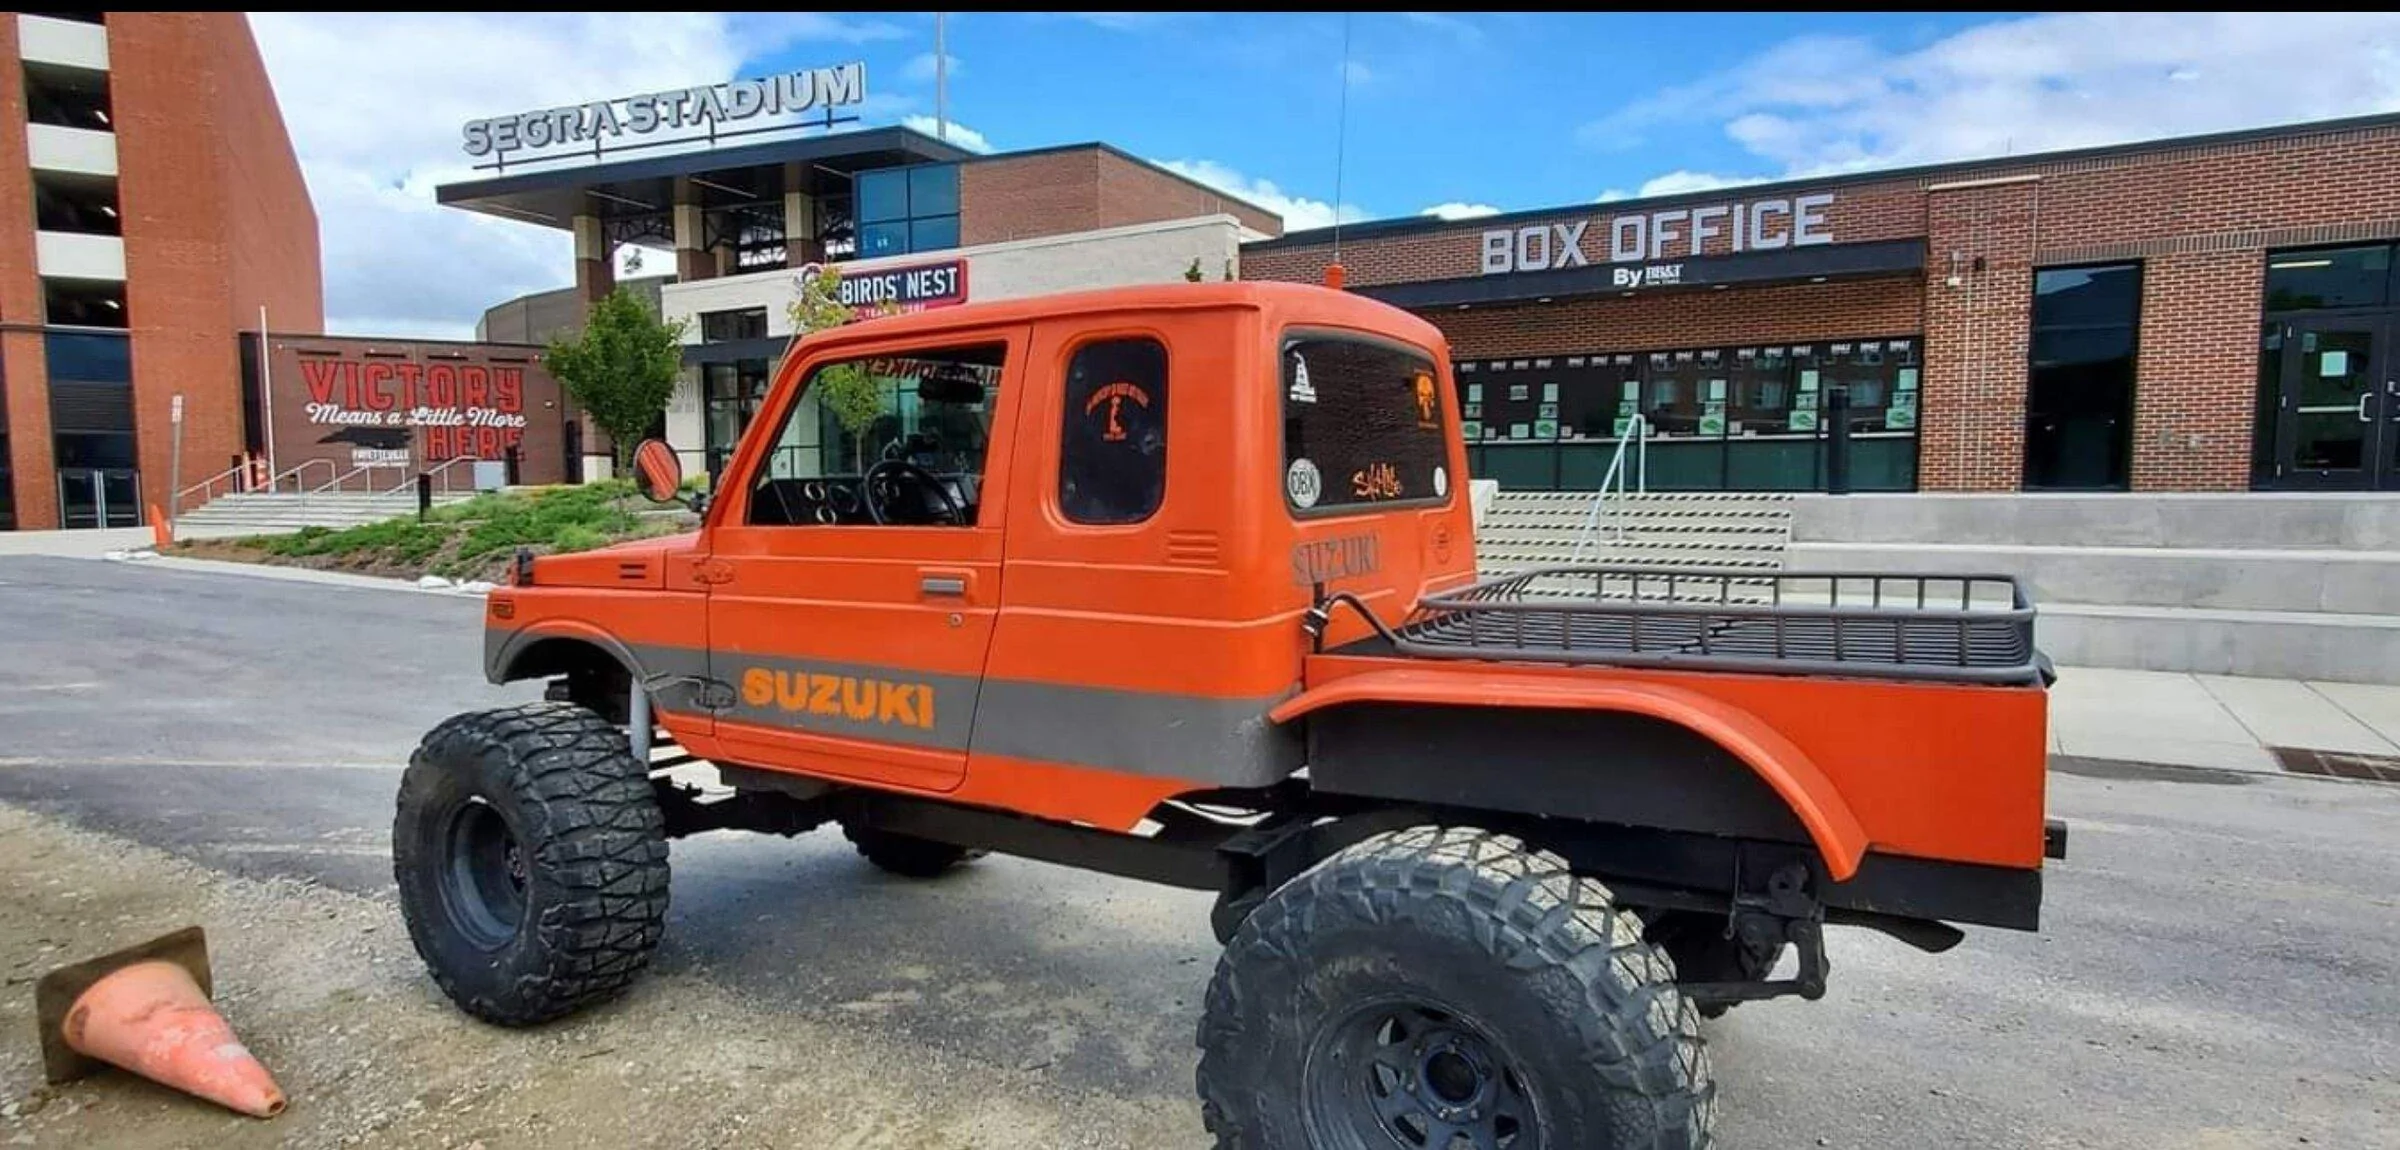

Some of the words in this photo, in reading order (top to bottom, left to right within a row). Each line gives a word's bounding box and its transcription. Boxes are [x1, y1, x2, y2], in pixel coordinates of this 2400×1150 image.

[463, 104, 618, 156] SEGRA
[626, 61, 864, 134] STADIUM
[1483, 220, 1589, 275] BOX
[1611, 194, 1834, 262] OFFICE
[906, 267, 957, 299] NEST
[1613, 267, 1644, 288] By
[300, 359, 525, 411] VICTORY
[305, 402, 382, 426] Means
[387, 411, 402, 425] a
[406, 406, 463, 427] Little
[466, 406, 528, 428] More
[1293, 531, 1380, 585] SUZUKI
[742, 667, 934, 728] SUZUKI
